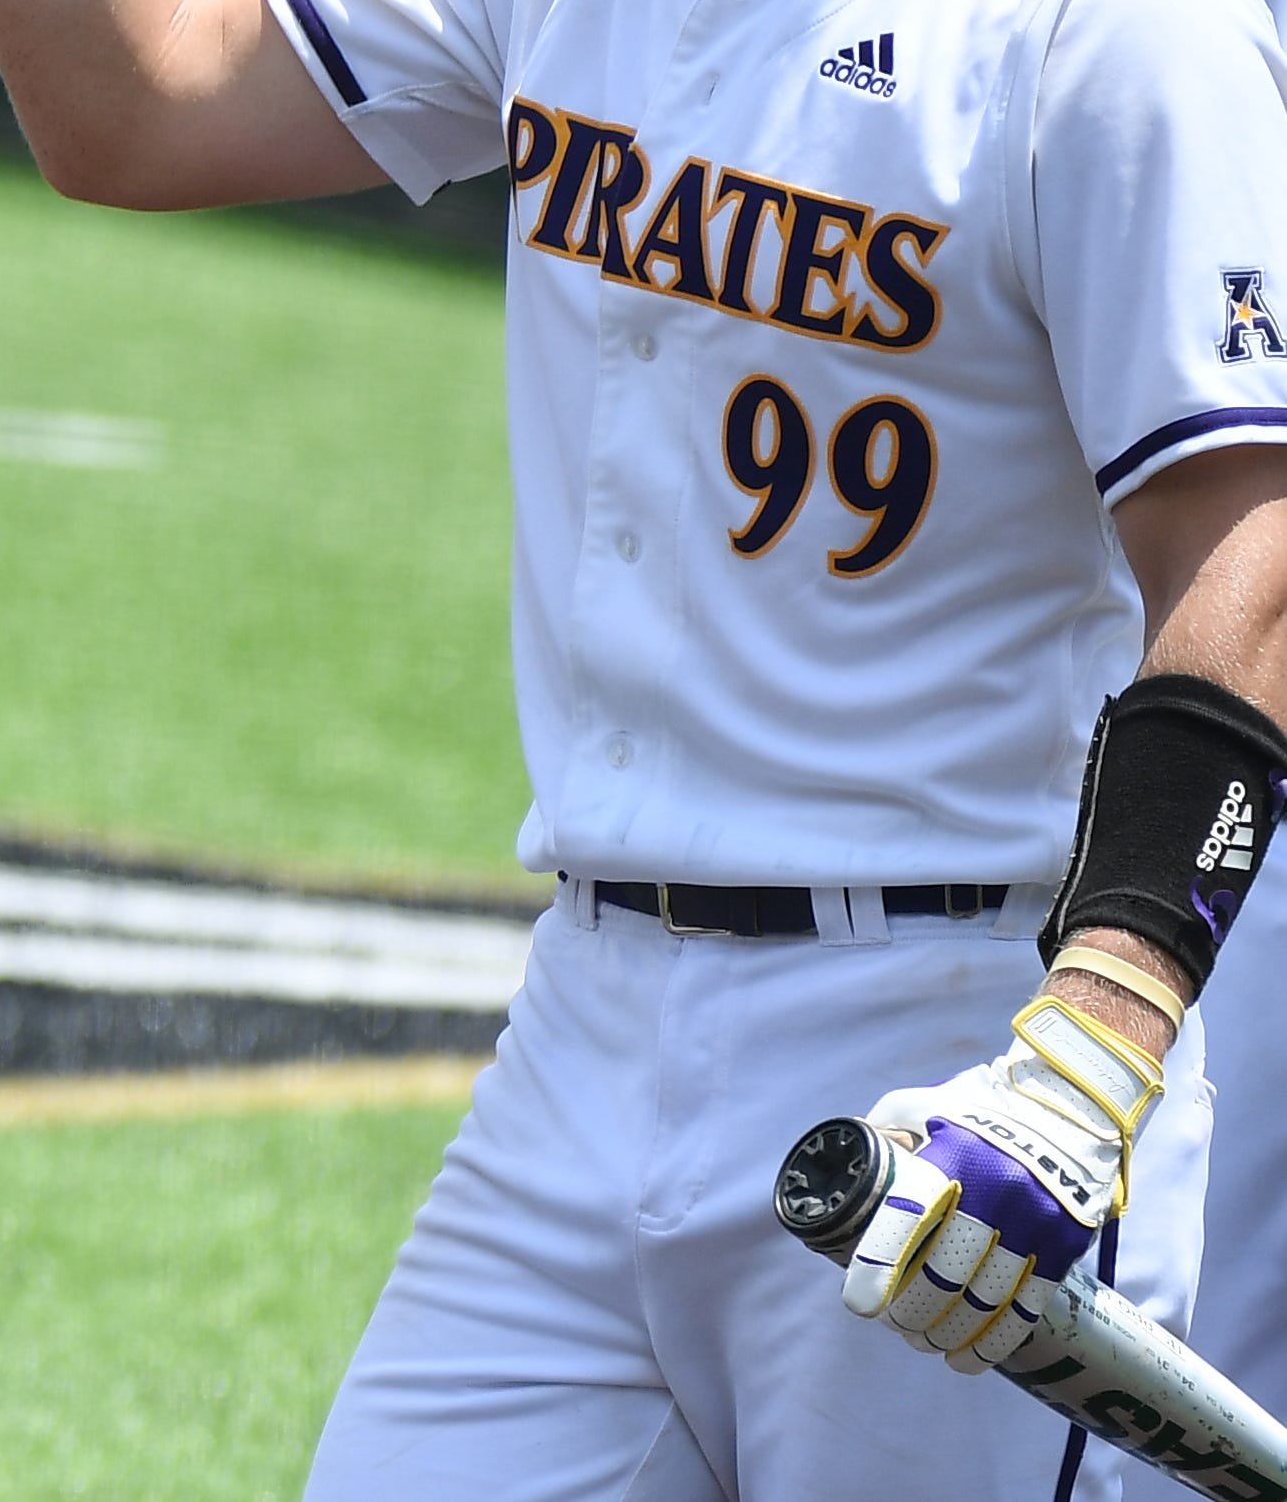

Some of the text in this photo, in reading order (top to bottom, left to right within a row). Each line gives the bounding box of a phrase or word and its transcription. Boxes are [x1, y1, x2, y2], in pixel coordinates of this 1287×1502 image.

[819, 58, 897, 98] adidas
[508, 96, 950, 354] PIRATES
[722, 372, 938, 580] 99
[1196, 780, 1246, 872] adidas
[962, 1114, 1091, 1206] EASTON
[993, 1331, 1287, 1502] EAST
